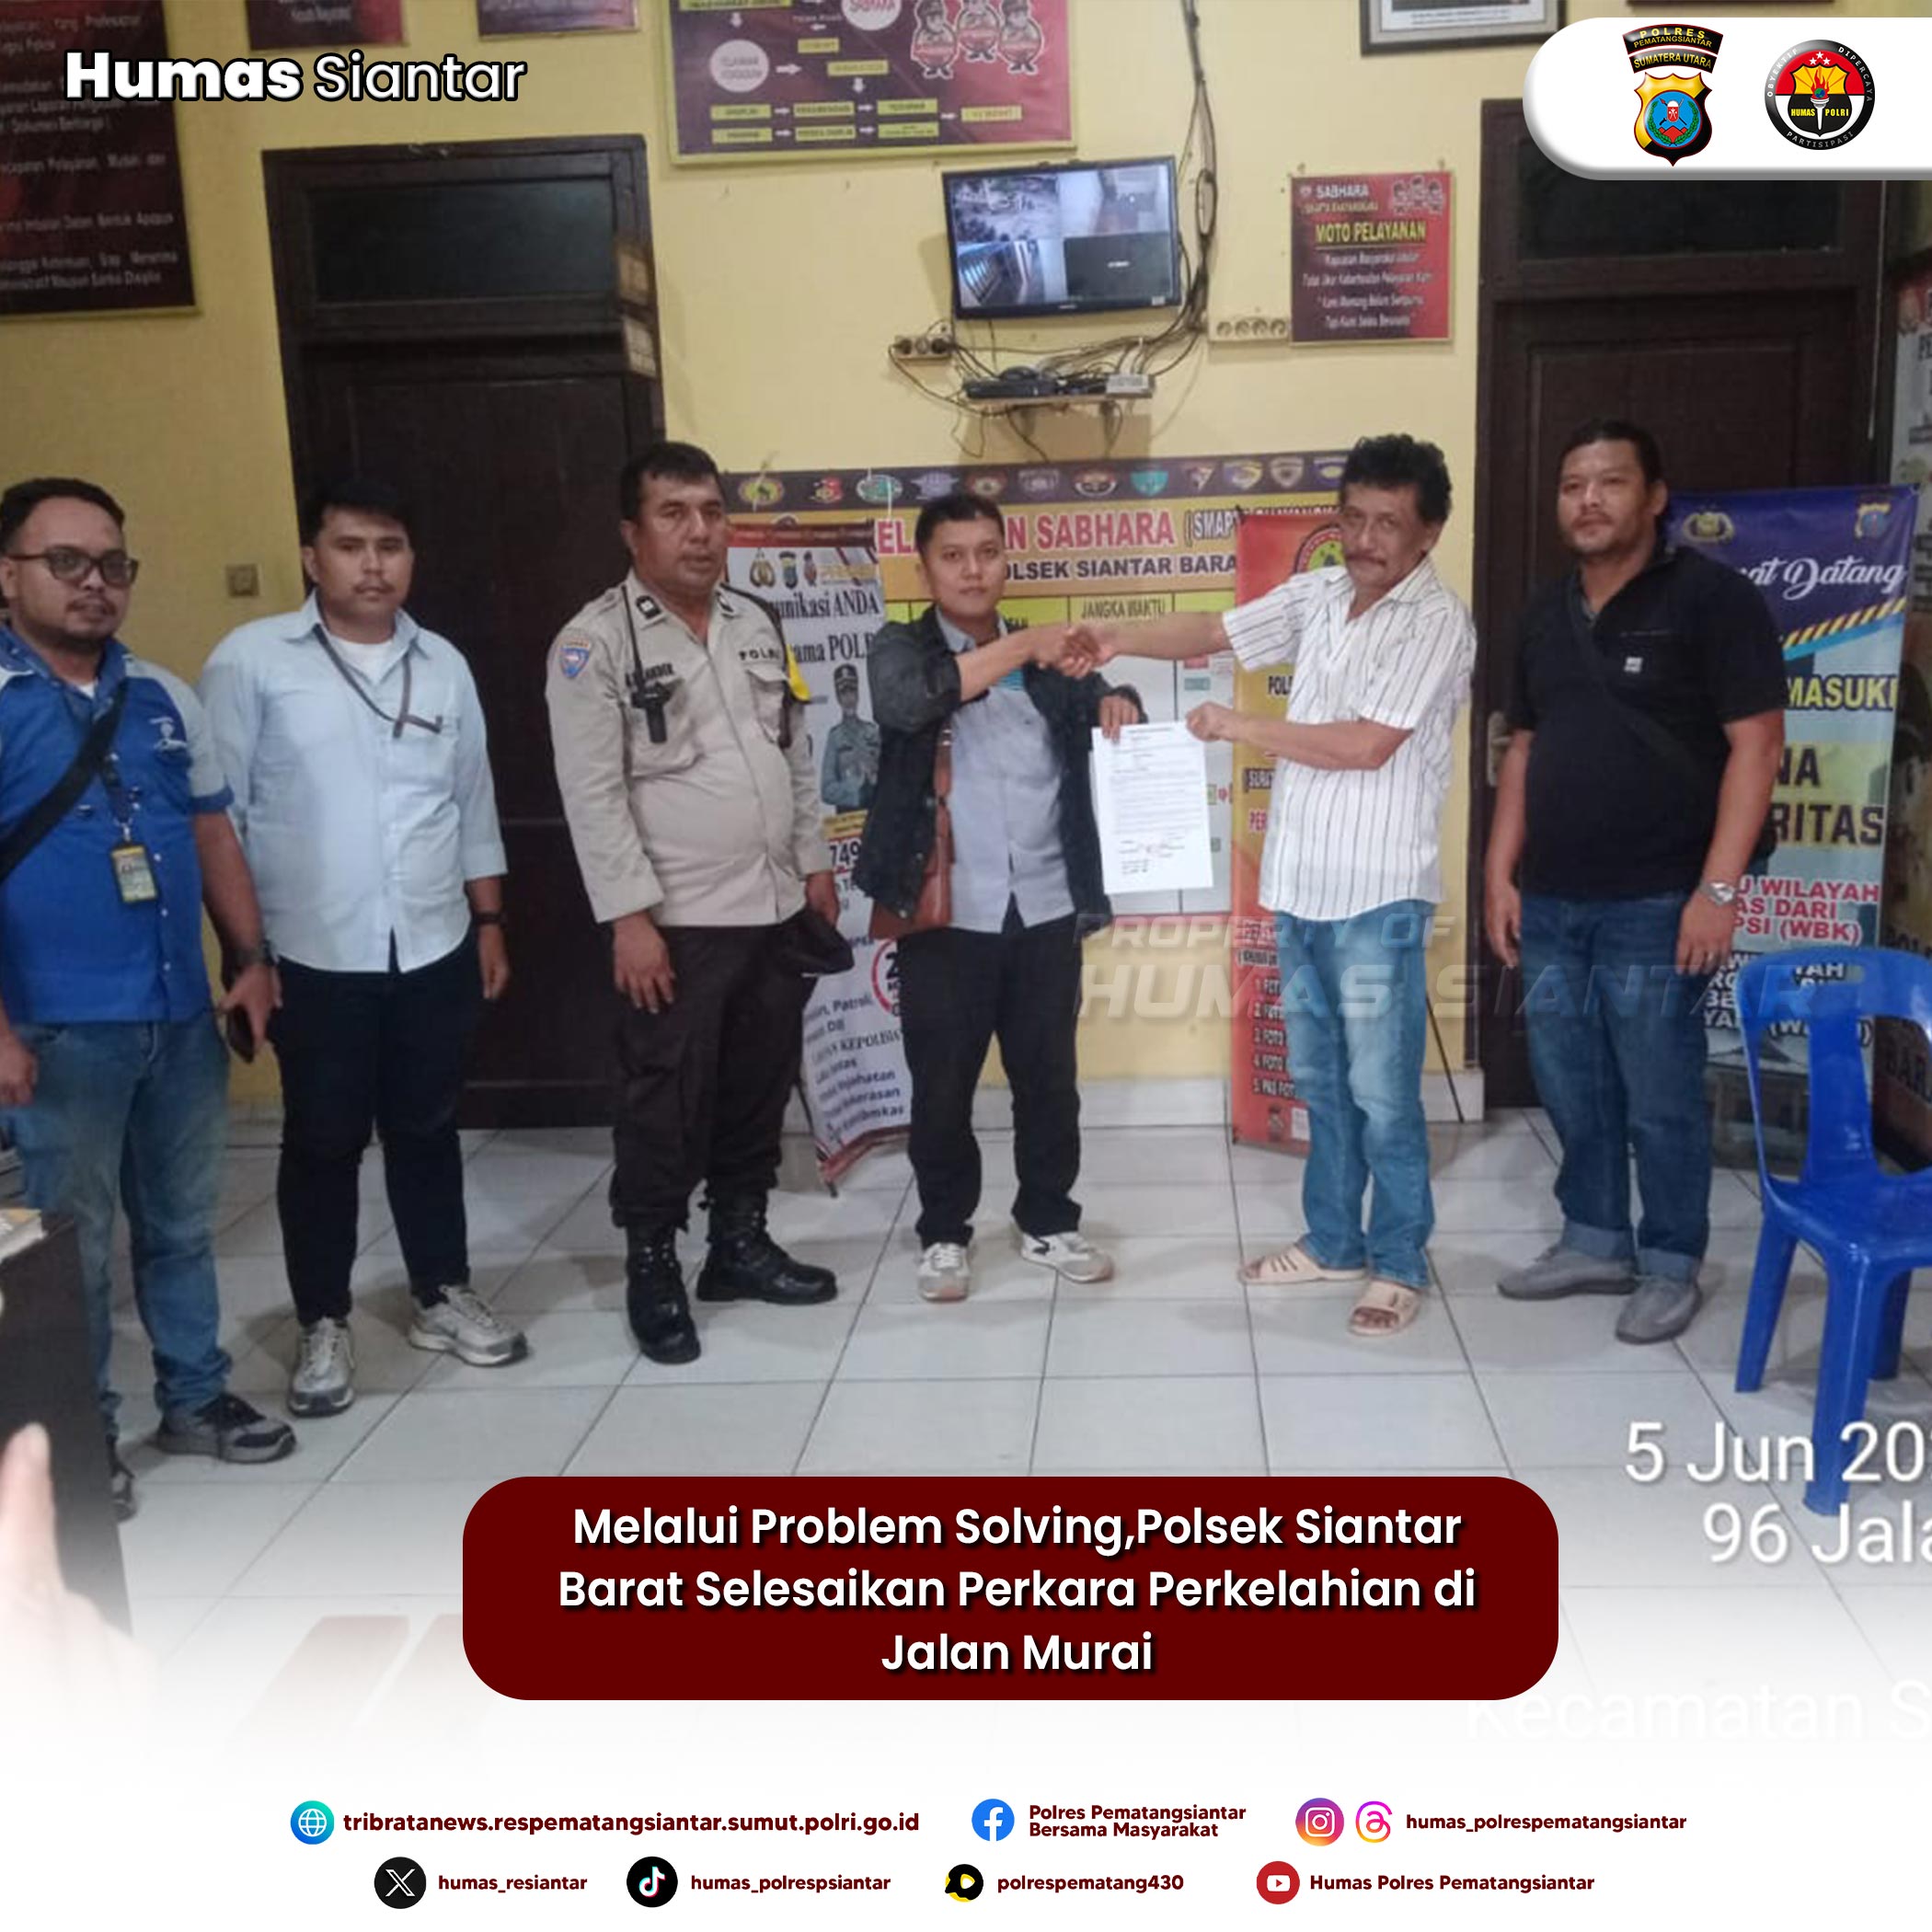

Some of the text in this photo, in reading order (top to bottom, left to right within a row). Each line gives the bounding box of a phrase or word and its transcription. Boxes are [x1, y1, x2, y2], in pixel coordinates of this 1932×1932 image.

[1317, 184, 1370, 199] SABHARA
[1315, 220, 1427, 244] MOTO PELAYANAN
[1036, 511, 1175, 550] SABHARA
[1076, 555, 1173, 578] SIANTAR
[1179, 554, 1236, 574] BARA
[1783, 555, 1904, 601] Datang
[833, 589, 880, 617] ANDA
[1081, 598, 1166, 620] JANGKA WAKTU
[1787, 675, 1898, 711] MASUKI
[1776, 747, 1822, 788] NA
[1770, 803, 1886, 846] RITAS
[1760, 879, 1880, 903] WILAYAH
[1775, 899, 1836, 919] DARI
[1779, 921, 1861, 946] (WBK)
